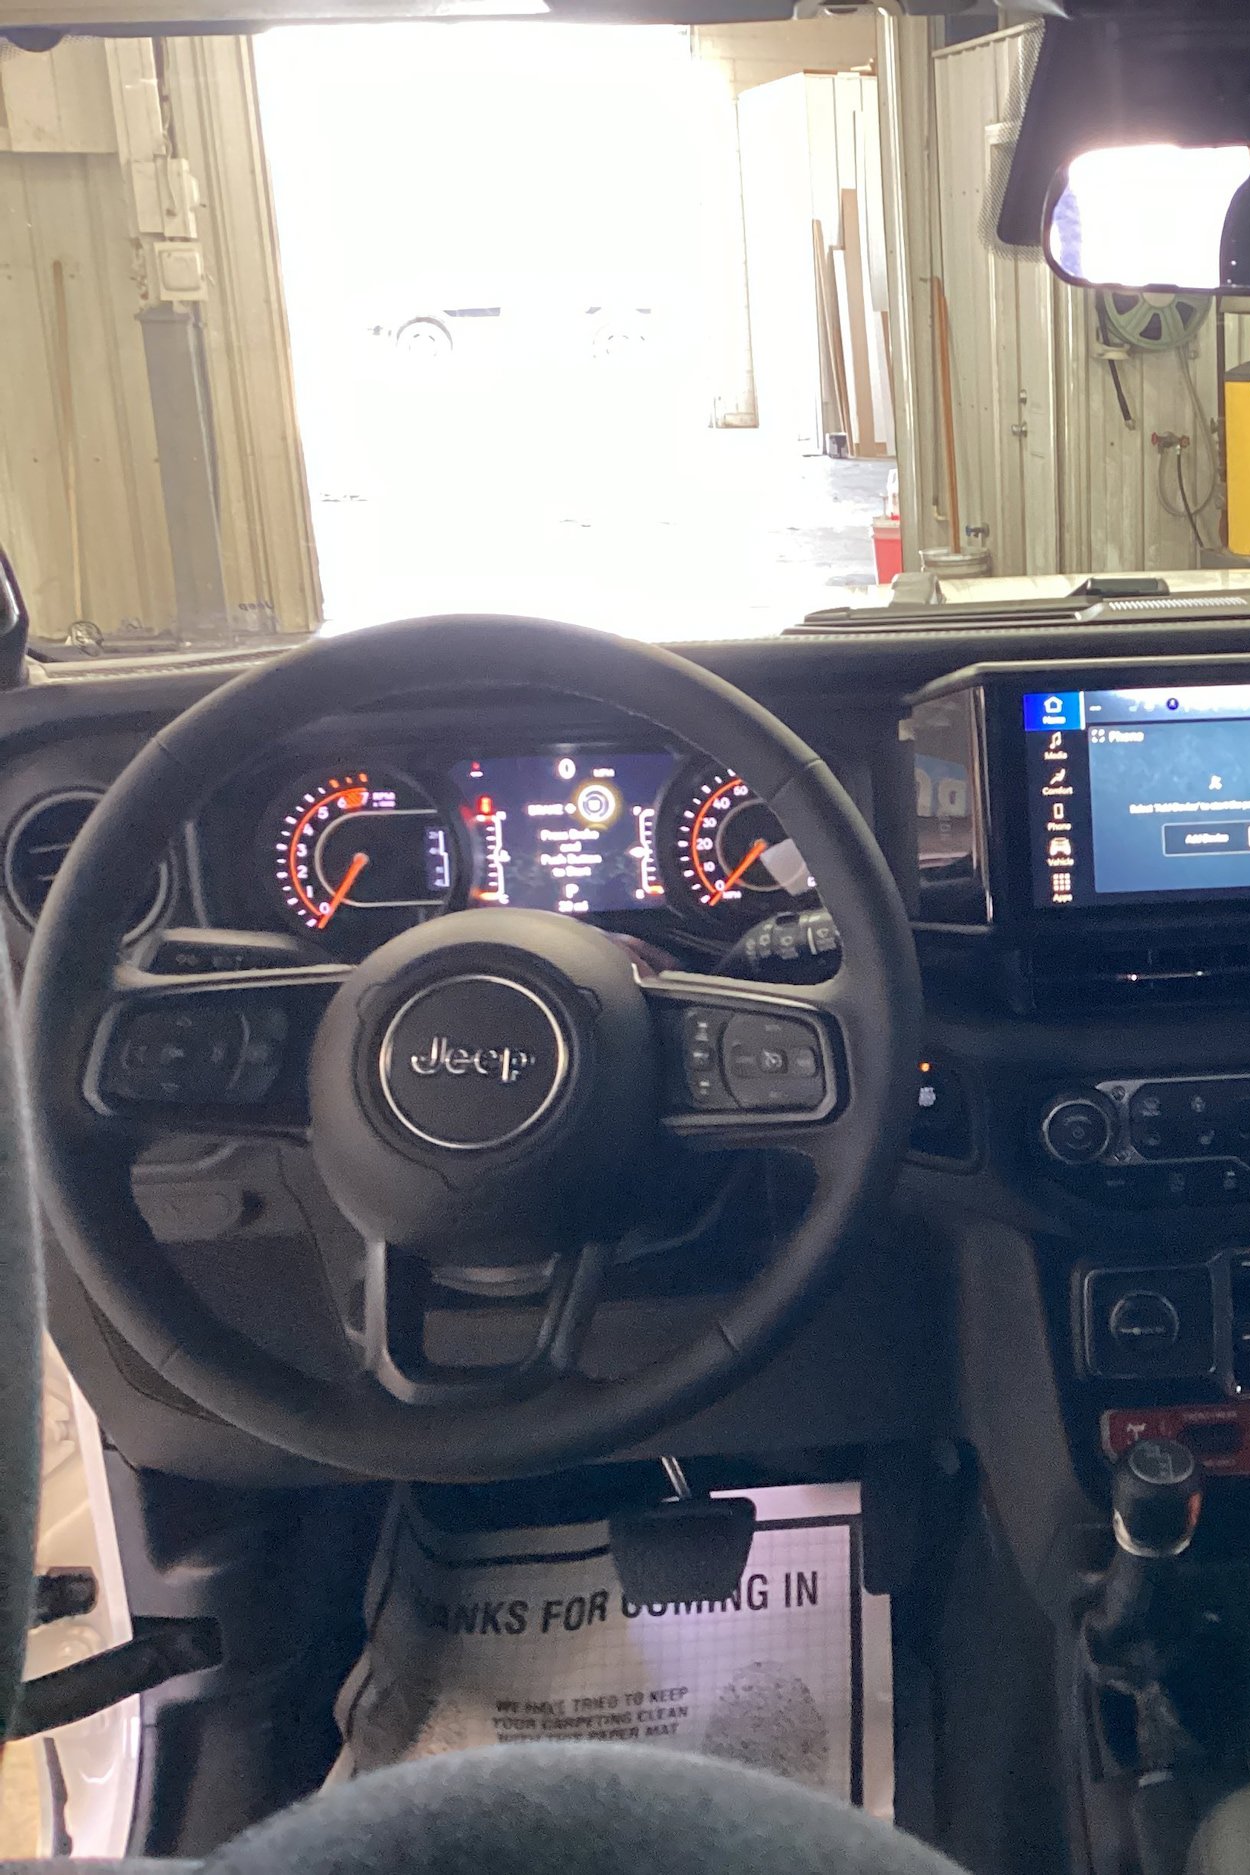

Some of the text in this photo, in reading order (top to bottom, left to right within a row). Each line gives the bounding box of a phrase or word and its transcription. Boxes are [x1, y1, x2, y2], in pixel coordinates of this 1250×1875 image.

[318, 806, 329, 820] 5
[303, 823, 314, 836] 4
[702, 817, 717, 828] 30
[296, 843, 308, 858] 3
[696, 837, 714, 850] 20
[297, 864, 308, 879] 2
[306, 885, 314, 898] 1
[566, 884, 579, 898] P
[715, 880, 726, 891] 0
[319, 902, 330, 914] 0
[411, 1036, 535, 1084] Jeep
[540, 1588, 609, 1634] FOR
[784, 1570, 819, 1608] IN
[574, 1694, 618, 1712] TRIED
[624, 1691, 644, 1706] TO
[650, 1686, 689, 1703] KEEP
[638, 1706, 689, 1724] CLEAN
[646, 1722, 680, 1737] MAT
